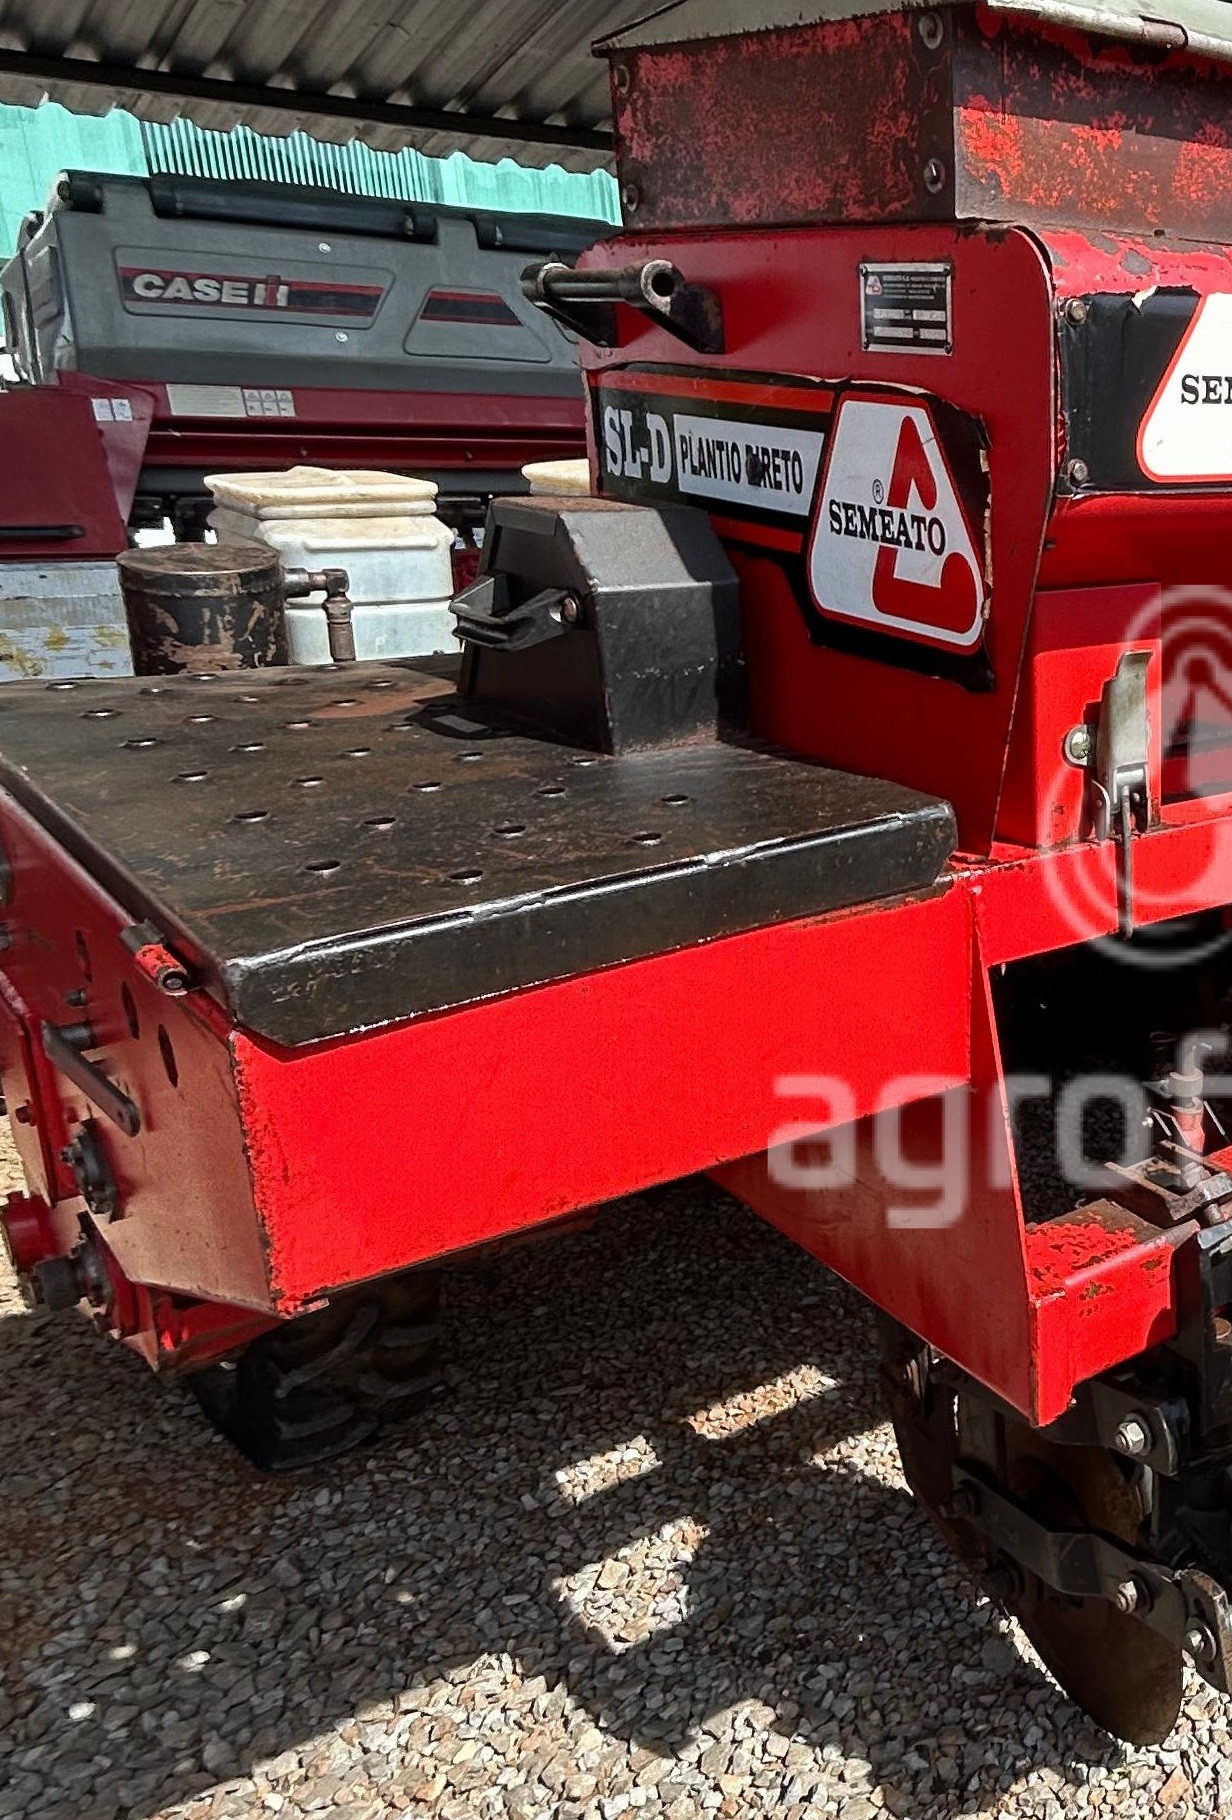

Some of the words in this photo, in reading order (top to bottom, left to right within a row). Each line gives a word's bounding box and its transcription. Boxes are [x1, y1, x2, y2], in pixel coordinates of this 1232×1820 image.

[133, 273, 250, 304] CASE
[604, 405, 673, 484] SL-D
[679, 433, 742, 484] PLANTIO
[829, 499, 946, 556] SEMEATO
